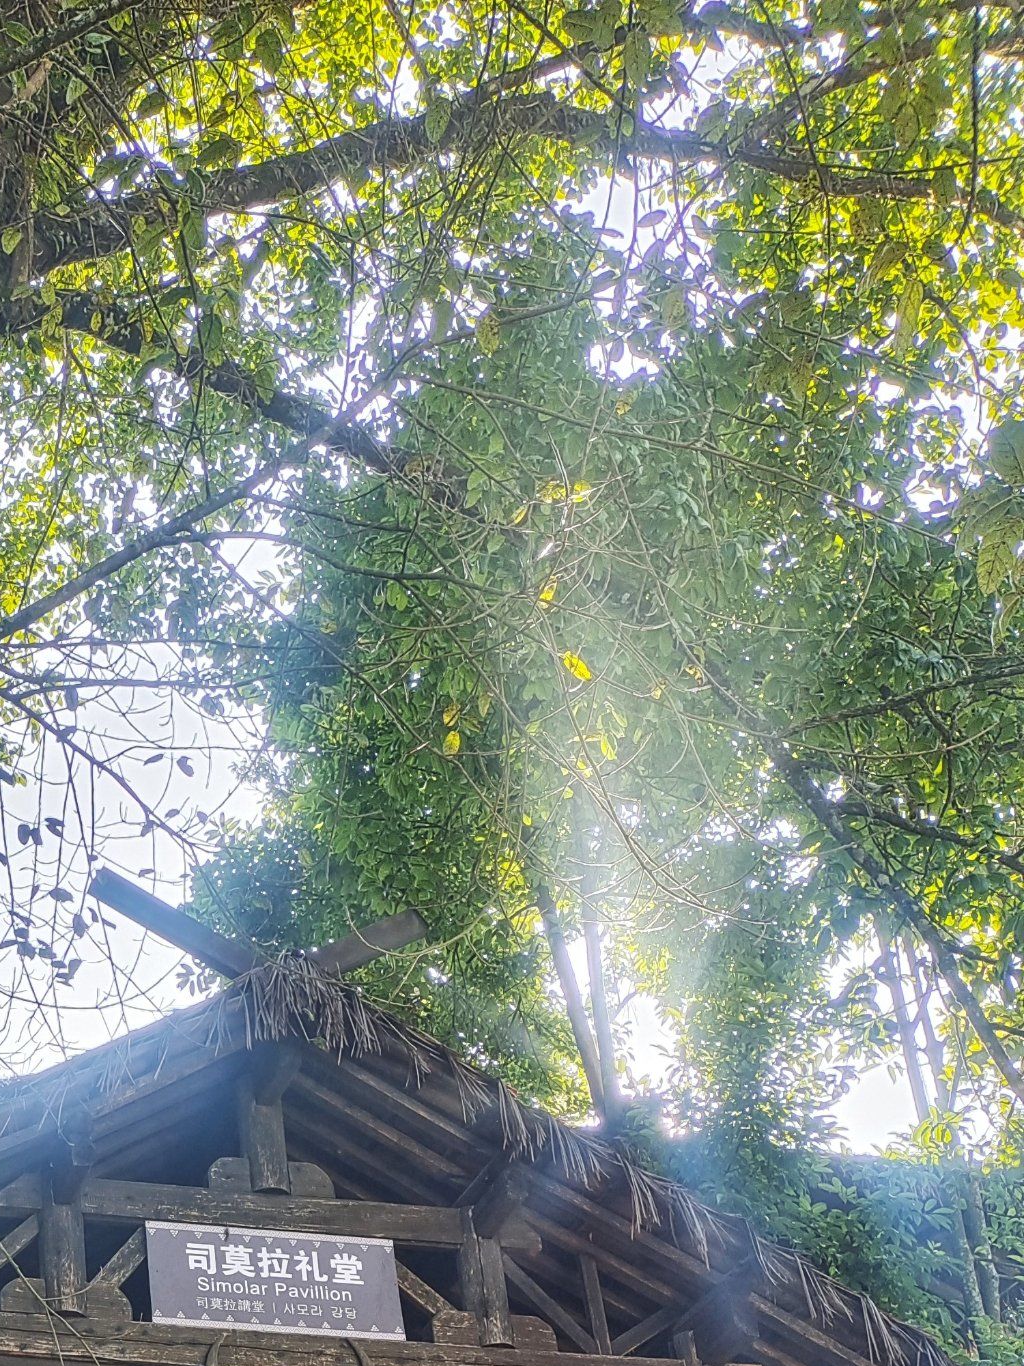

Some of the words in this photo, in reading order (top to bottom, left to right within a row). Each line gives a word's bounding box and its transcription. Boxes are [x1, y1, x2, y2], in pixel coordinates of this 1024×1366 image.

[185, 1242, 365, 1285] 司莫拉礼堂
[197, 1276, 268, 1297] Simolar
[275, 1283, 353, 1302] Pavillion
[283, 1302, 323, 1317] 사모라
[330, 1306, 357, 1319] 강당
